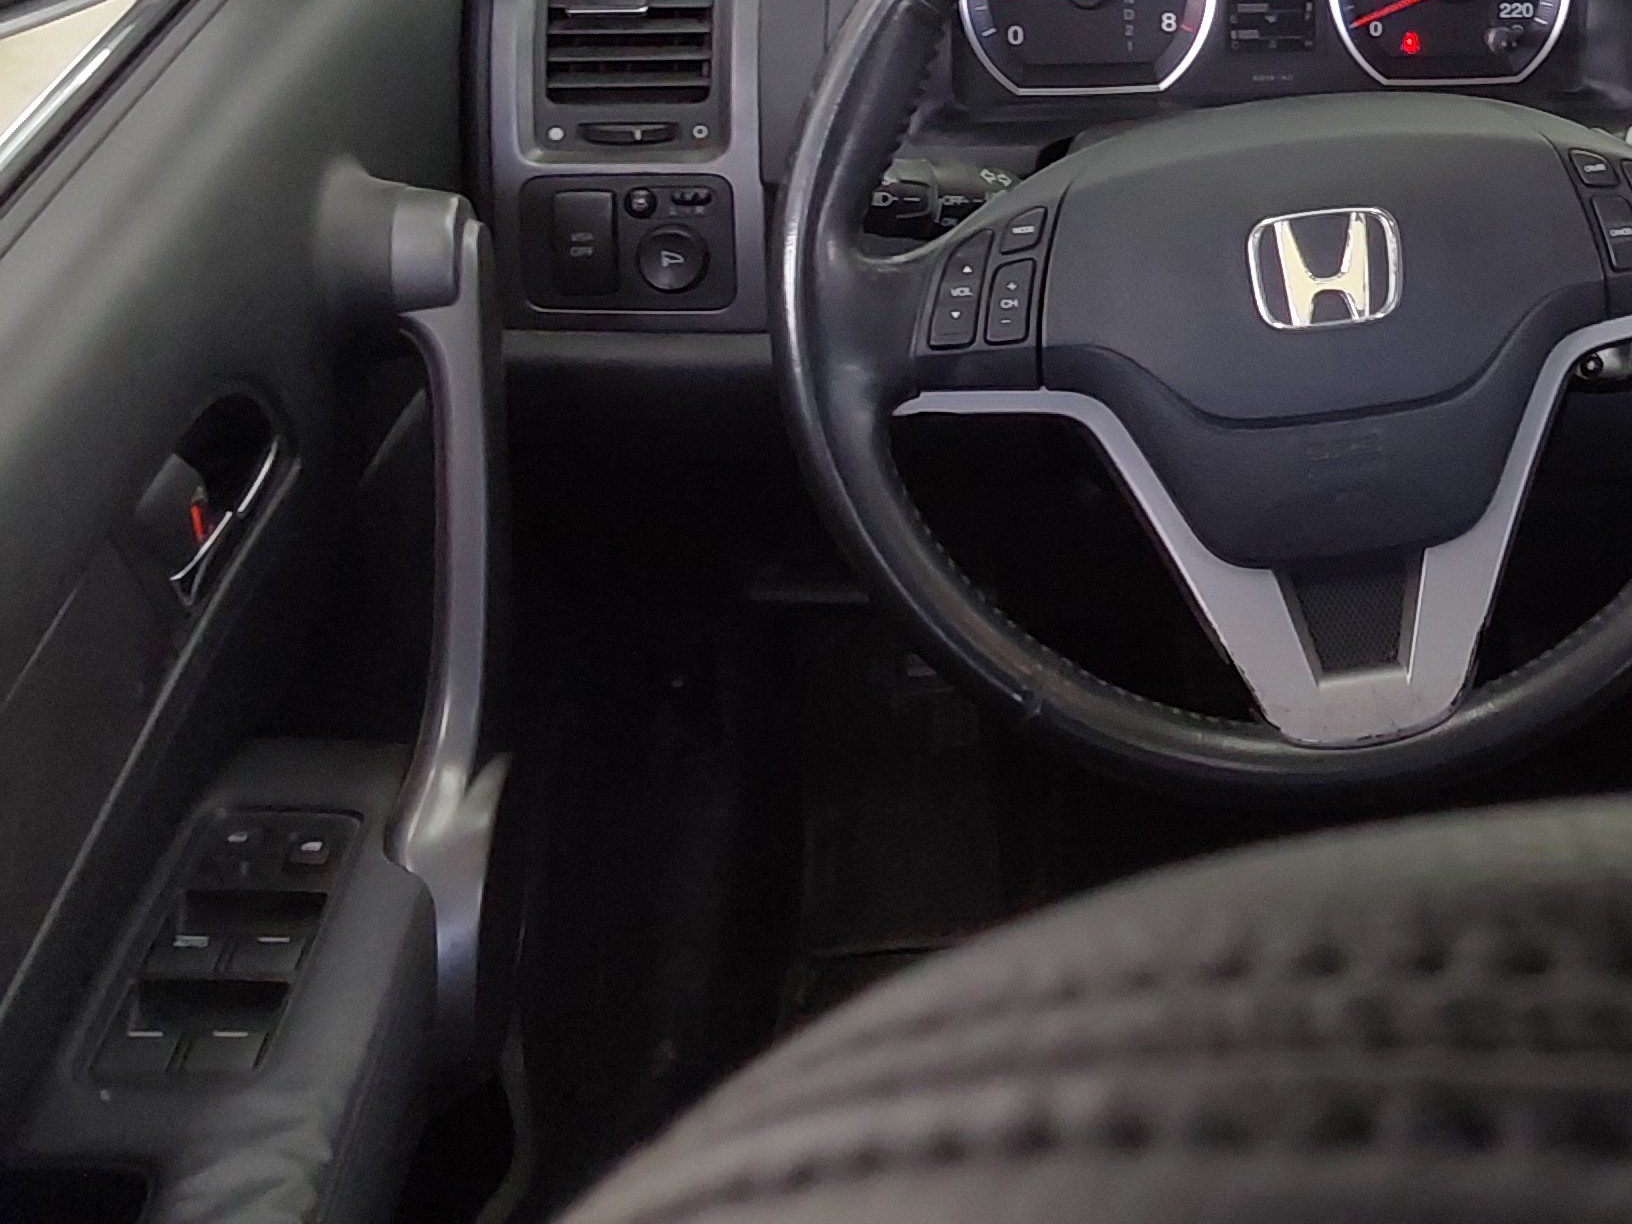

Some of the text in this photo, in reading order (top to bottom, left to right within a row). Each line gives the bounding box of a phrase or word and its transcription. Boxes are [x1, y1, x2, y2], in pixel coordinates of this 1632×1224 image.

[1499, 3, 1534, 18] 220
[1161, 12, 1177, 32] 8
[1369, 21, 1383, 37] 0
[1007, 25, 1024, 45] 0
[951, 287, 974, 297] VOL
[1000, 299, 1018, 309] CH
